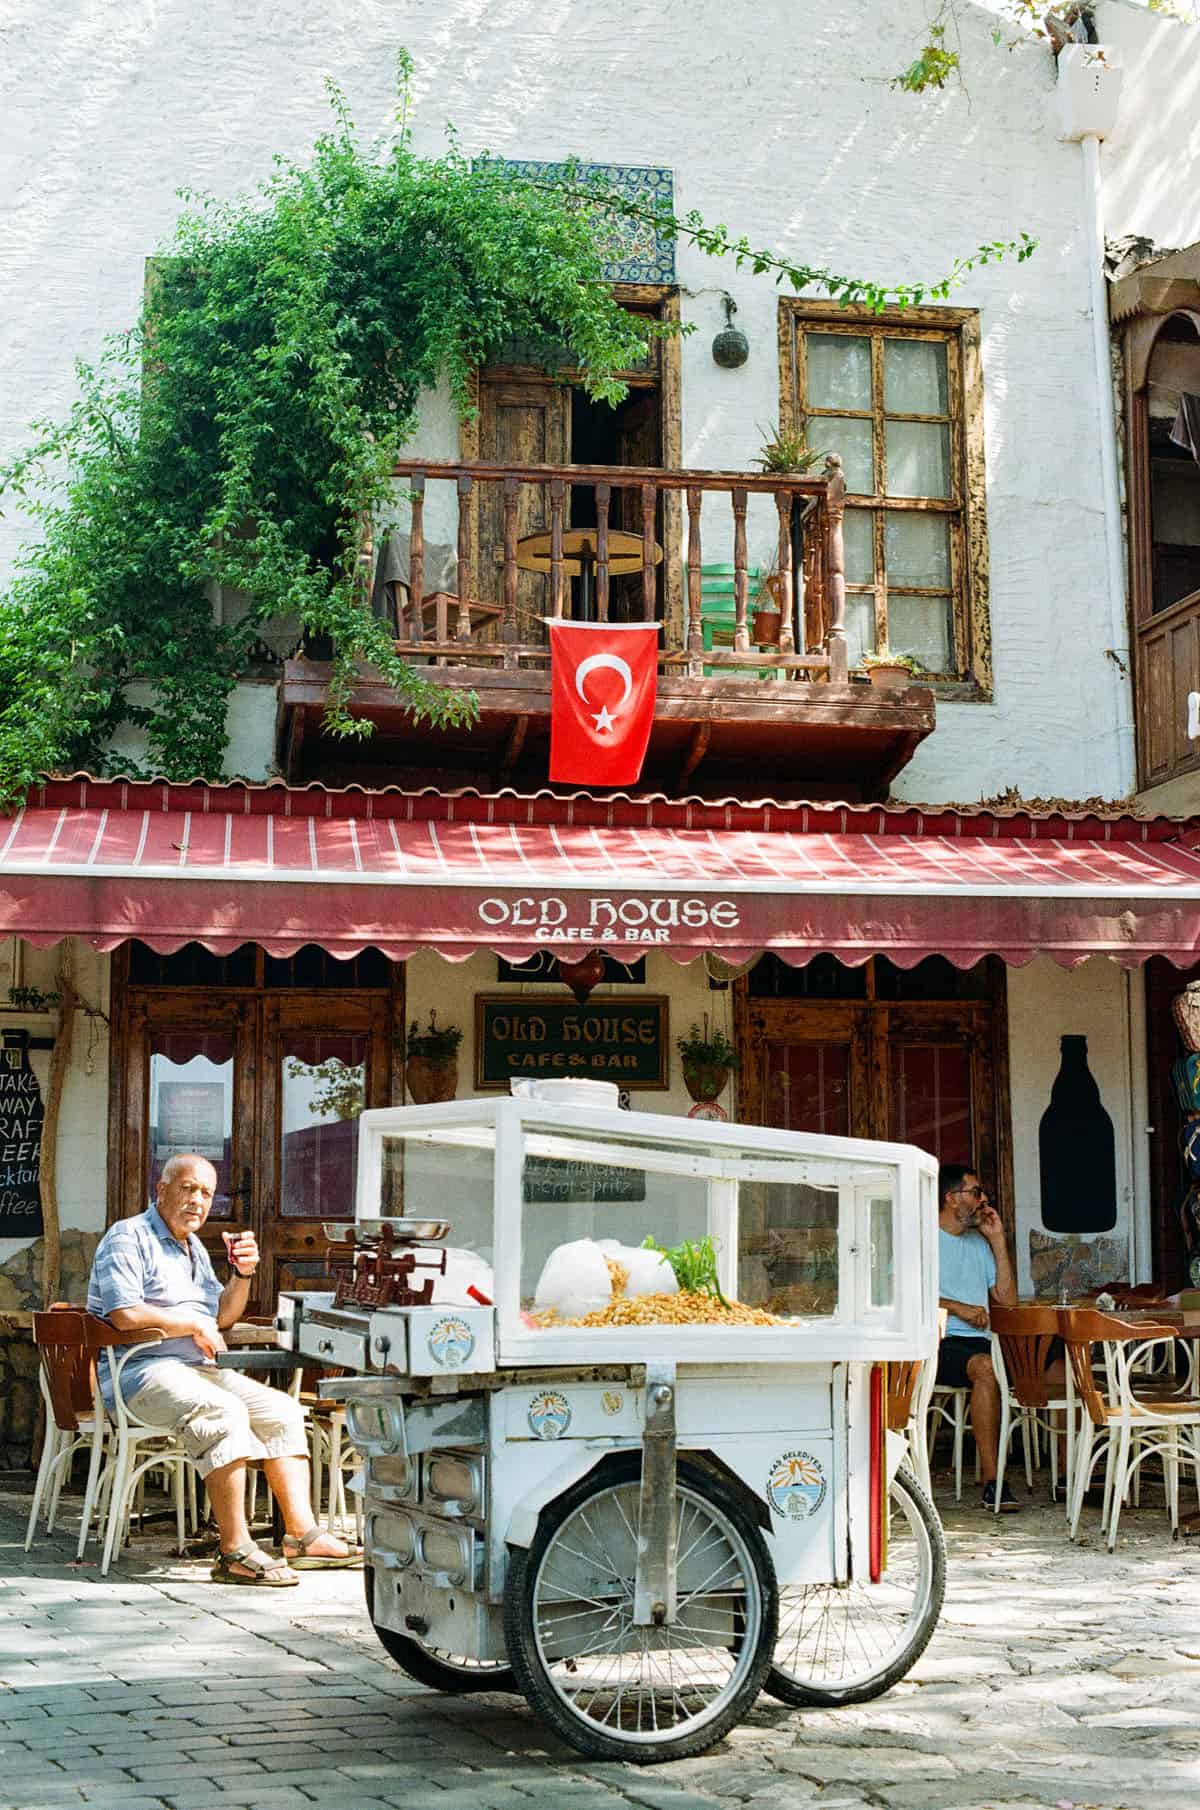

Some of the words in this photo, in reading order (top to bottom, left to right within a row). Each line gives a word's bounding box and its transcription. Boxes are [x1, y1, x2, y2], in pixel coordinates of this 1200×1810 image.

[478, 897, 568, 926] OLD
[588, 898, 740, 928] HOUSE
[535, 927, 595, 941] CAFE
[602, 927, 618, 941] &
[624, 928, 671, 942] BAR
[491, 1015, 547, 1041] OLD
[561, 1015, 657, 1043] HOUSE
[591, 1054, 640, 1069] BAR
[0, 1073, 39, 1093] TAKE
[0, 1117, 44, 1139] RAF
